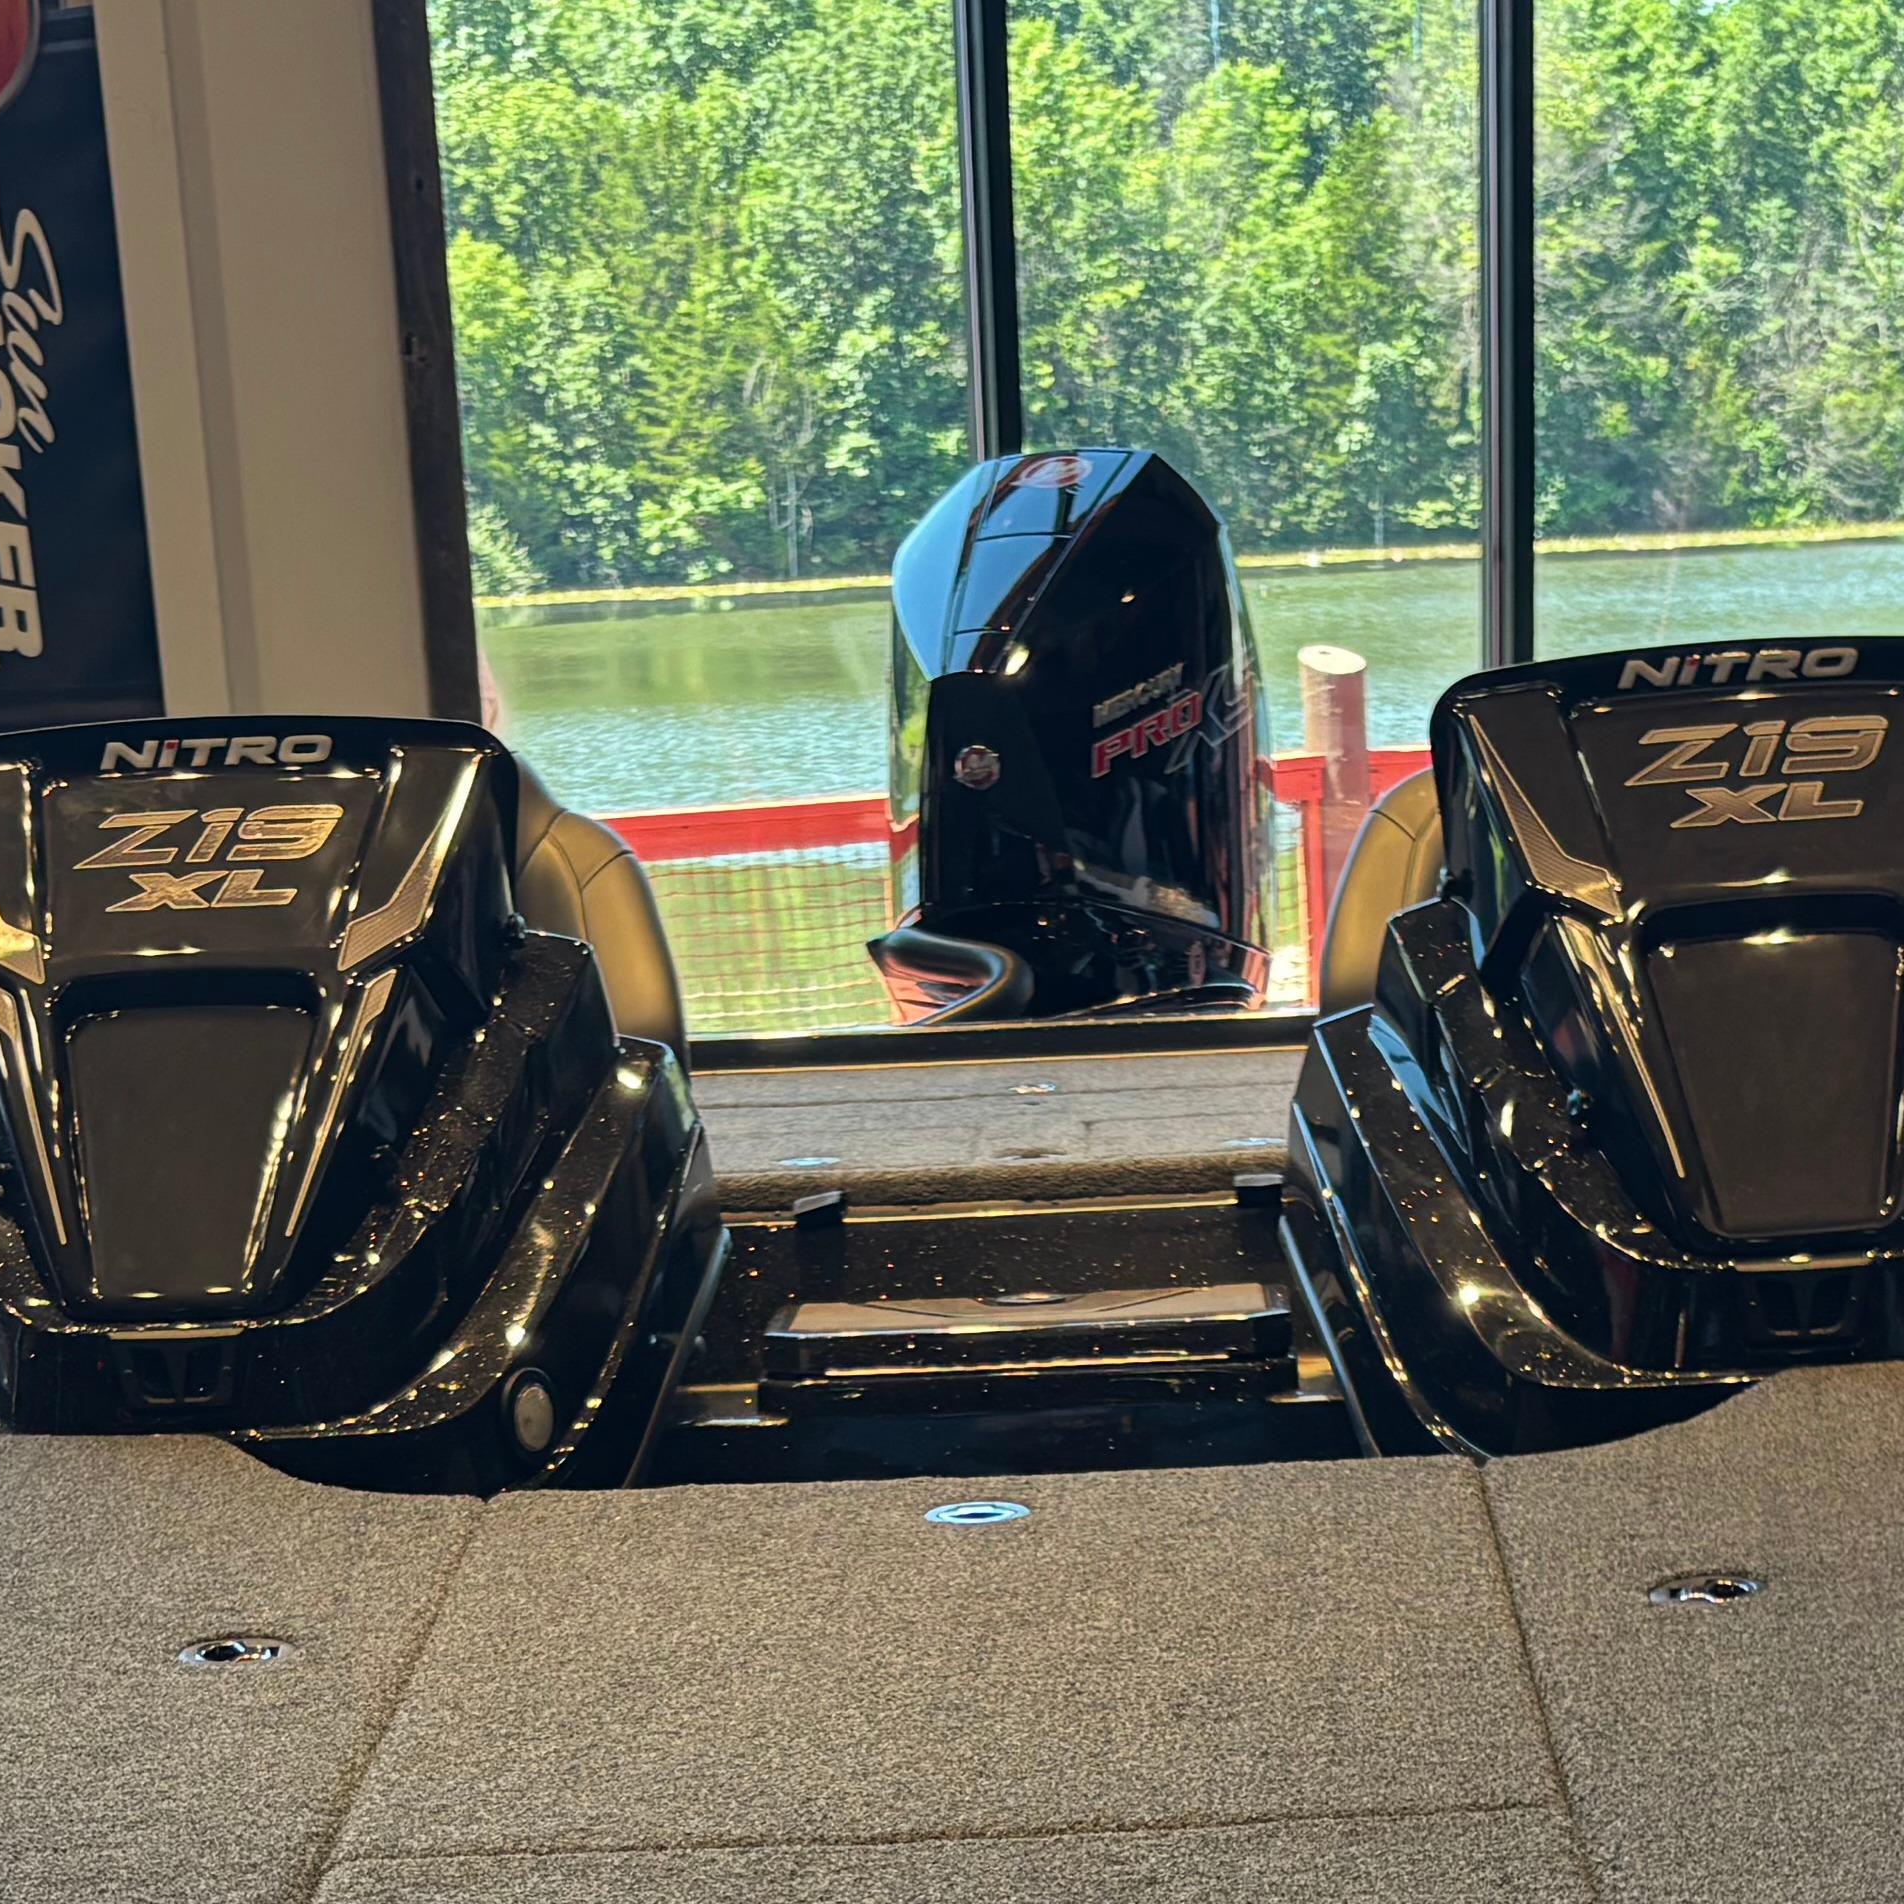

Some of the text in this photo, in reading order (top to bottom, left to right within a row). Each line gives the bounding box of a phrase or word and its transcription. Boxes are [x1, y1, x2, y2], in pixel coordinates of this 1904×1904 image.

[1617, 647, 1859, 690] NITRO
[99, 734, 333, 771] NITRO
[1091, 691, 1203, 778] PRO
[1623, 715, 1889, 787] Z19
[1669, 780, 1864, 829] XL
[72, 803, 345, 870] Z19
[104, 868, 298, 913] XL
